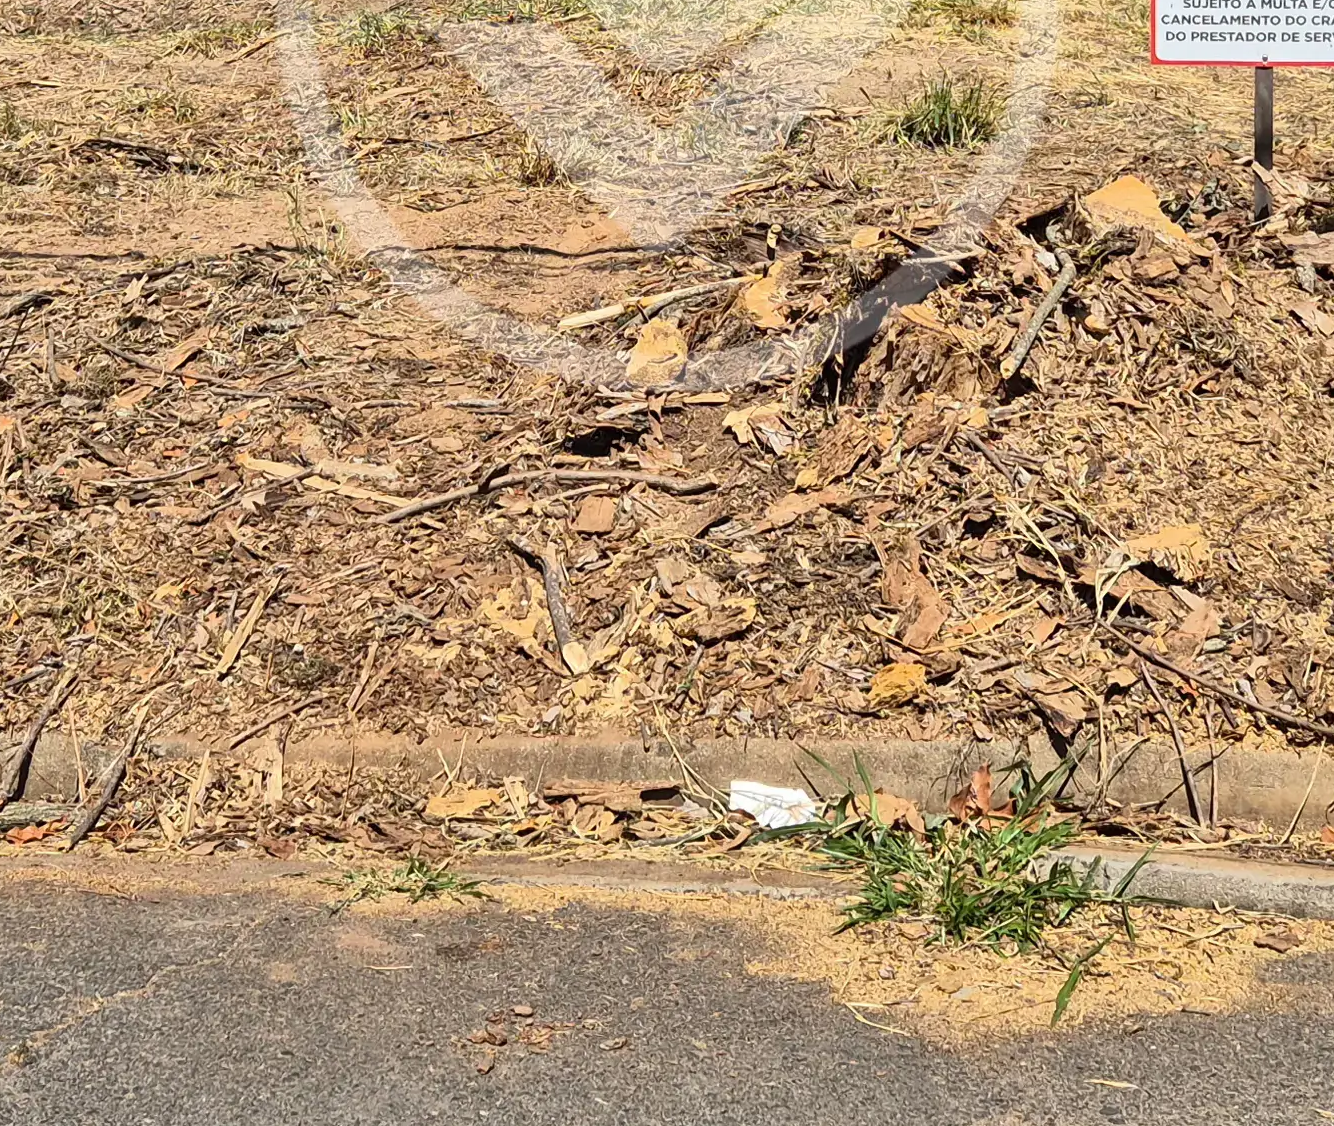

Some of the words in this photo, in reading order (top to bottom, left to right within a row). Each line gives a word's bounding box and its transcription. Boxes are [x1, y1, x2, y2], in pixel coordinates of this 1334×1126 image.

[1160, 14, 1282, 26] CANCELAMENTO
[1285, 15, 1307, 26] DO
[1165, 30, 1187, 42] DO
[1190, 31, 1277, 43] PRESTADOR
[1281, 31, 1300, 43] DE
